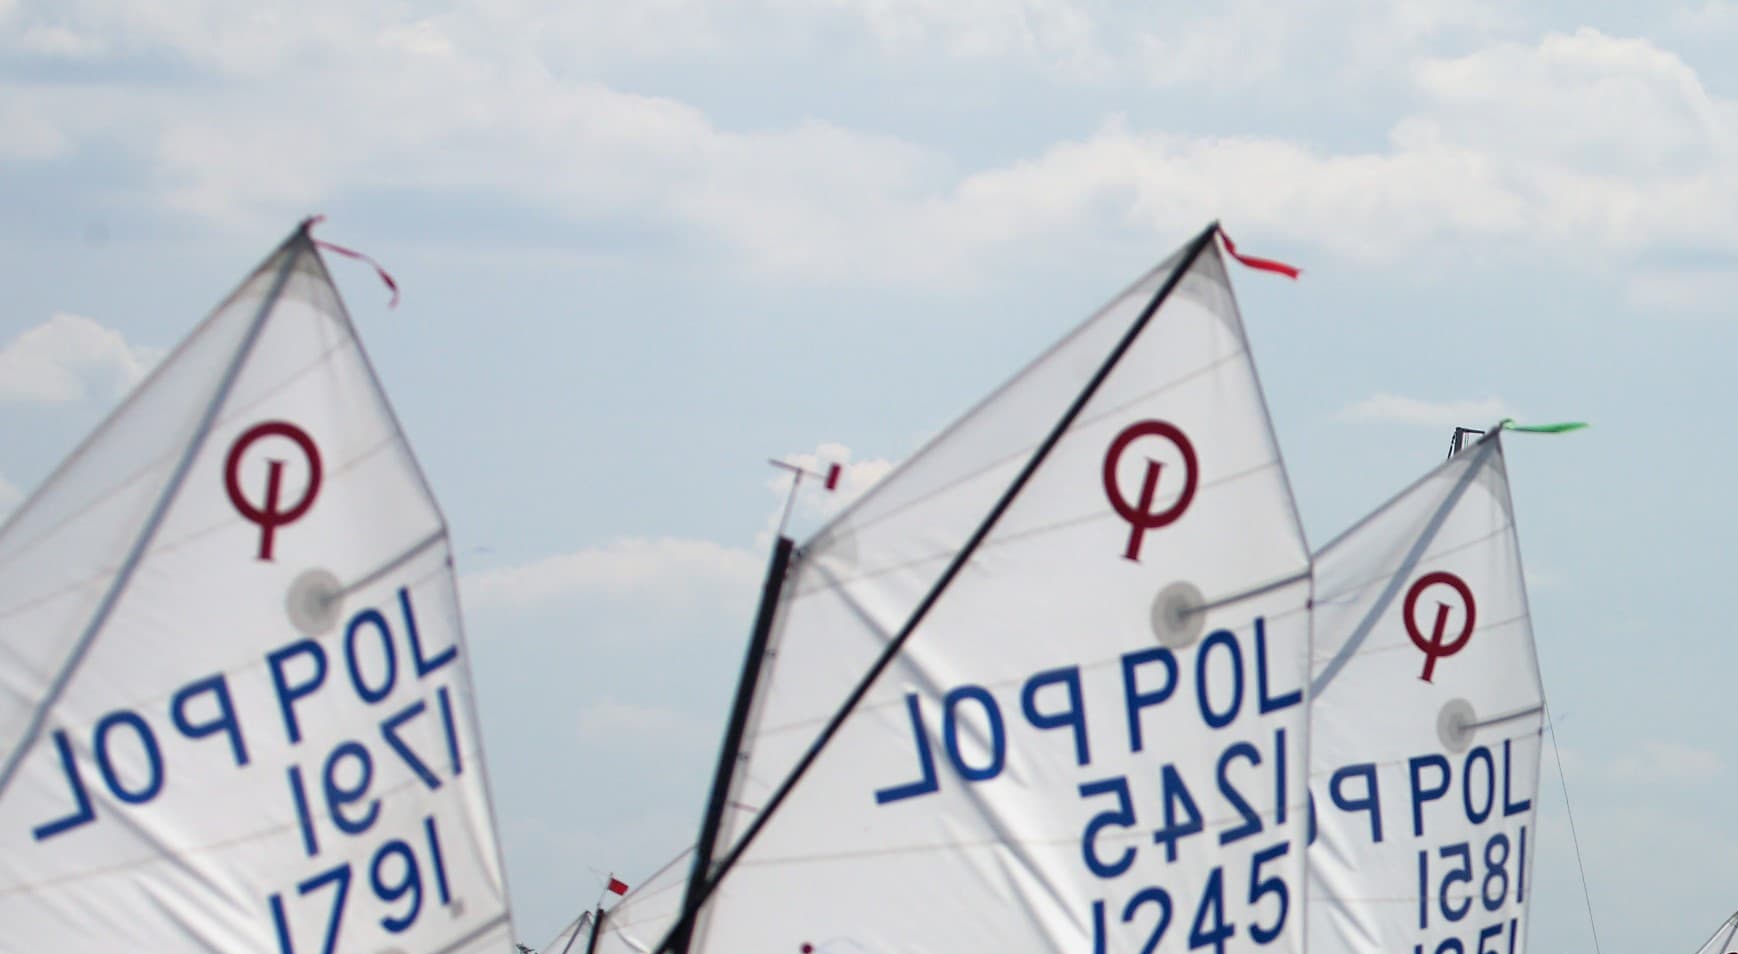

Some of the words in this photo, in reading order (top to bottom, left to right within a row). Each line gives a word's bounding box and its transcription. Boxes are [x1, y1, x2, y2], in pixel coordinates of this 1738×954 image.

[266, 587, 458, 744] POL
[1121, 617, 1303, 752] POL
[1409, 739, 1531, 836] POL
